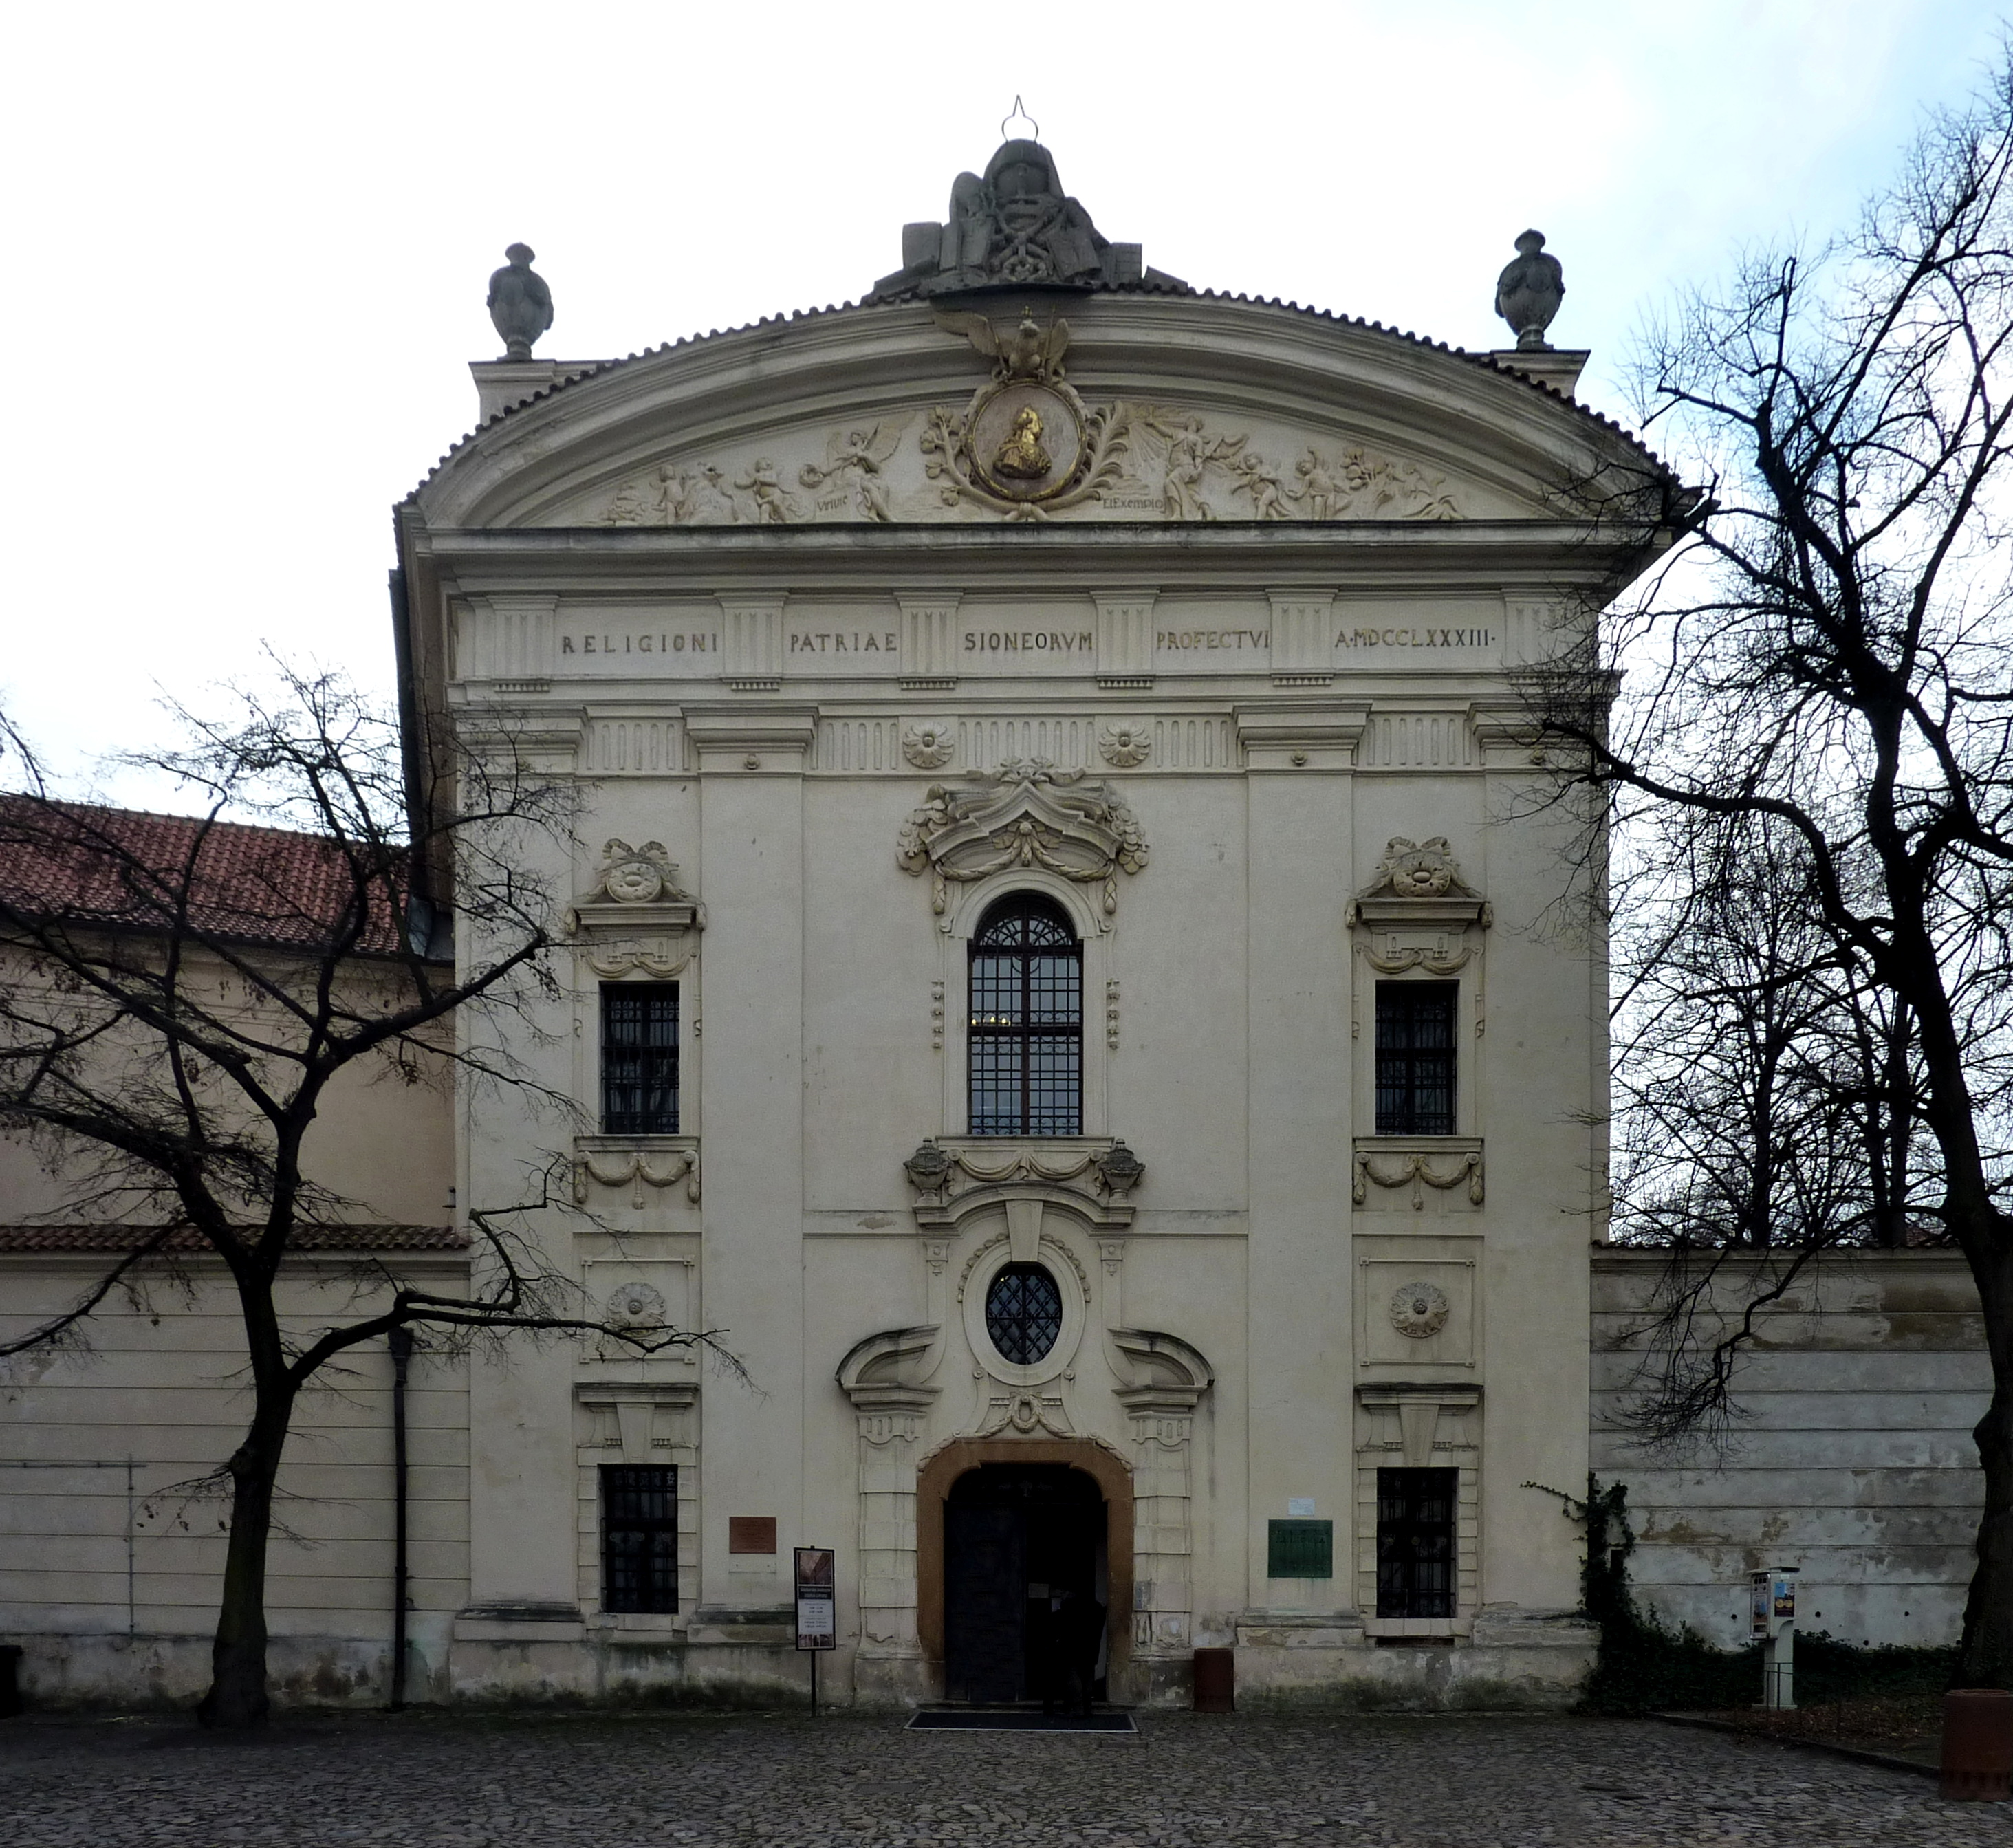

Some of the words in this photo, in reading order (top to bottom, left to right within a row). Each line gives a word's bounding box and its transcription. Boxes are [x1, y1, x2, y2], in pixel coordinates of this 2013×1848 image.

[562, 633, 717, 653] RELIGIONI
[791, 633, 897, 652] PATRIAE
[964, 632, 1092, 651] SIONEORVM
[1157, 630, 1269, 649] PROFECTVI
